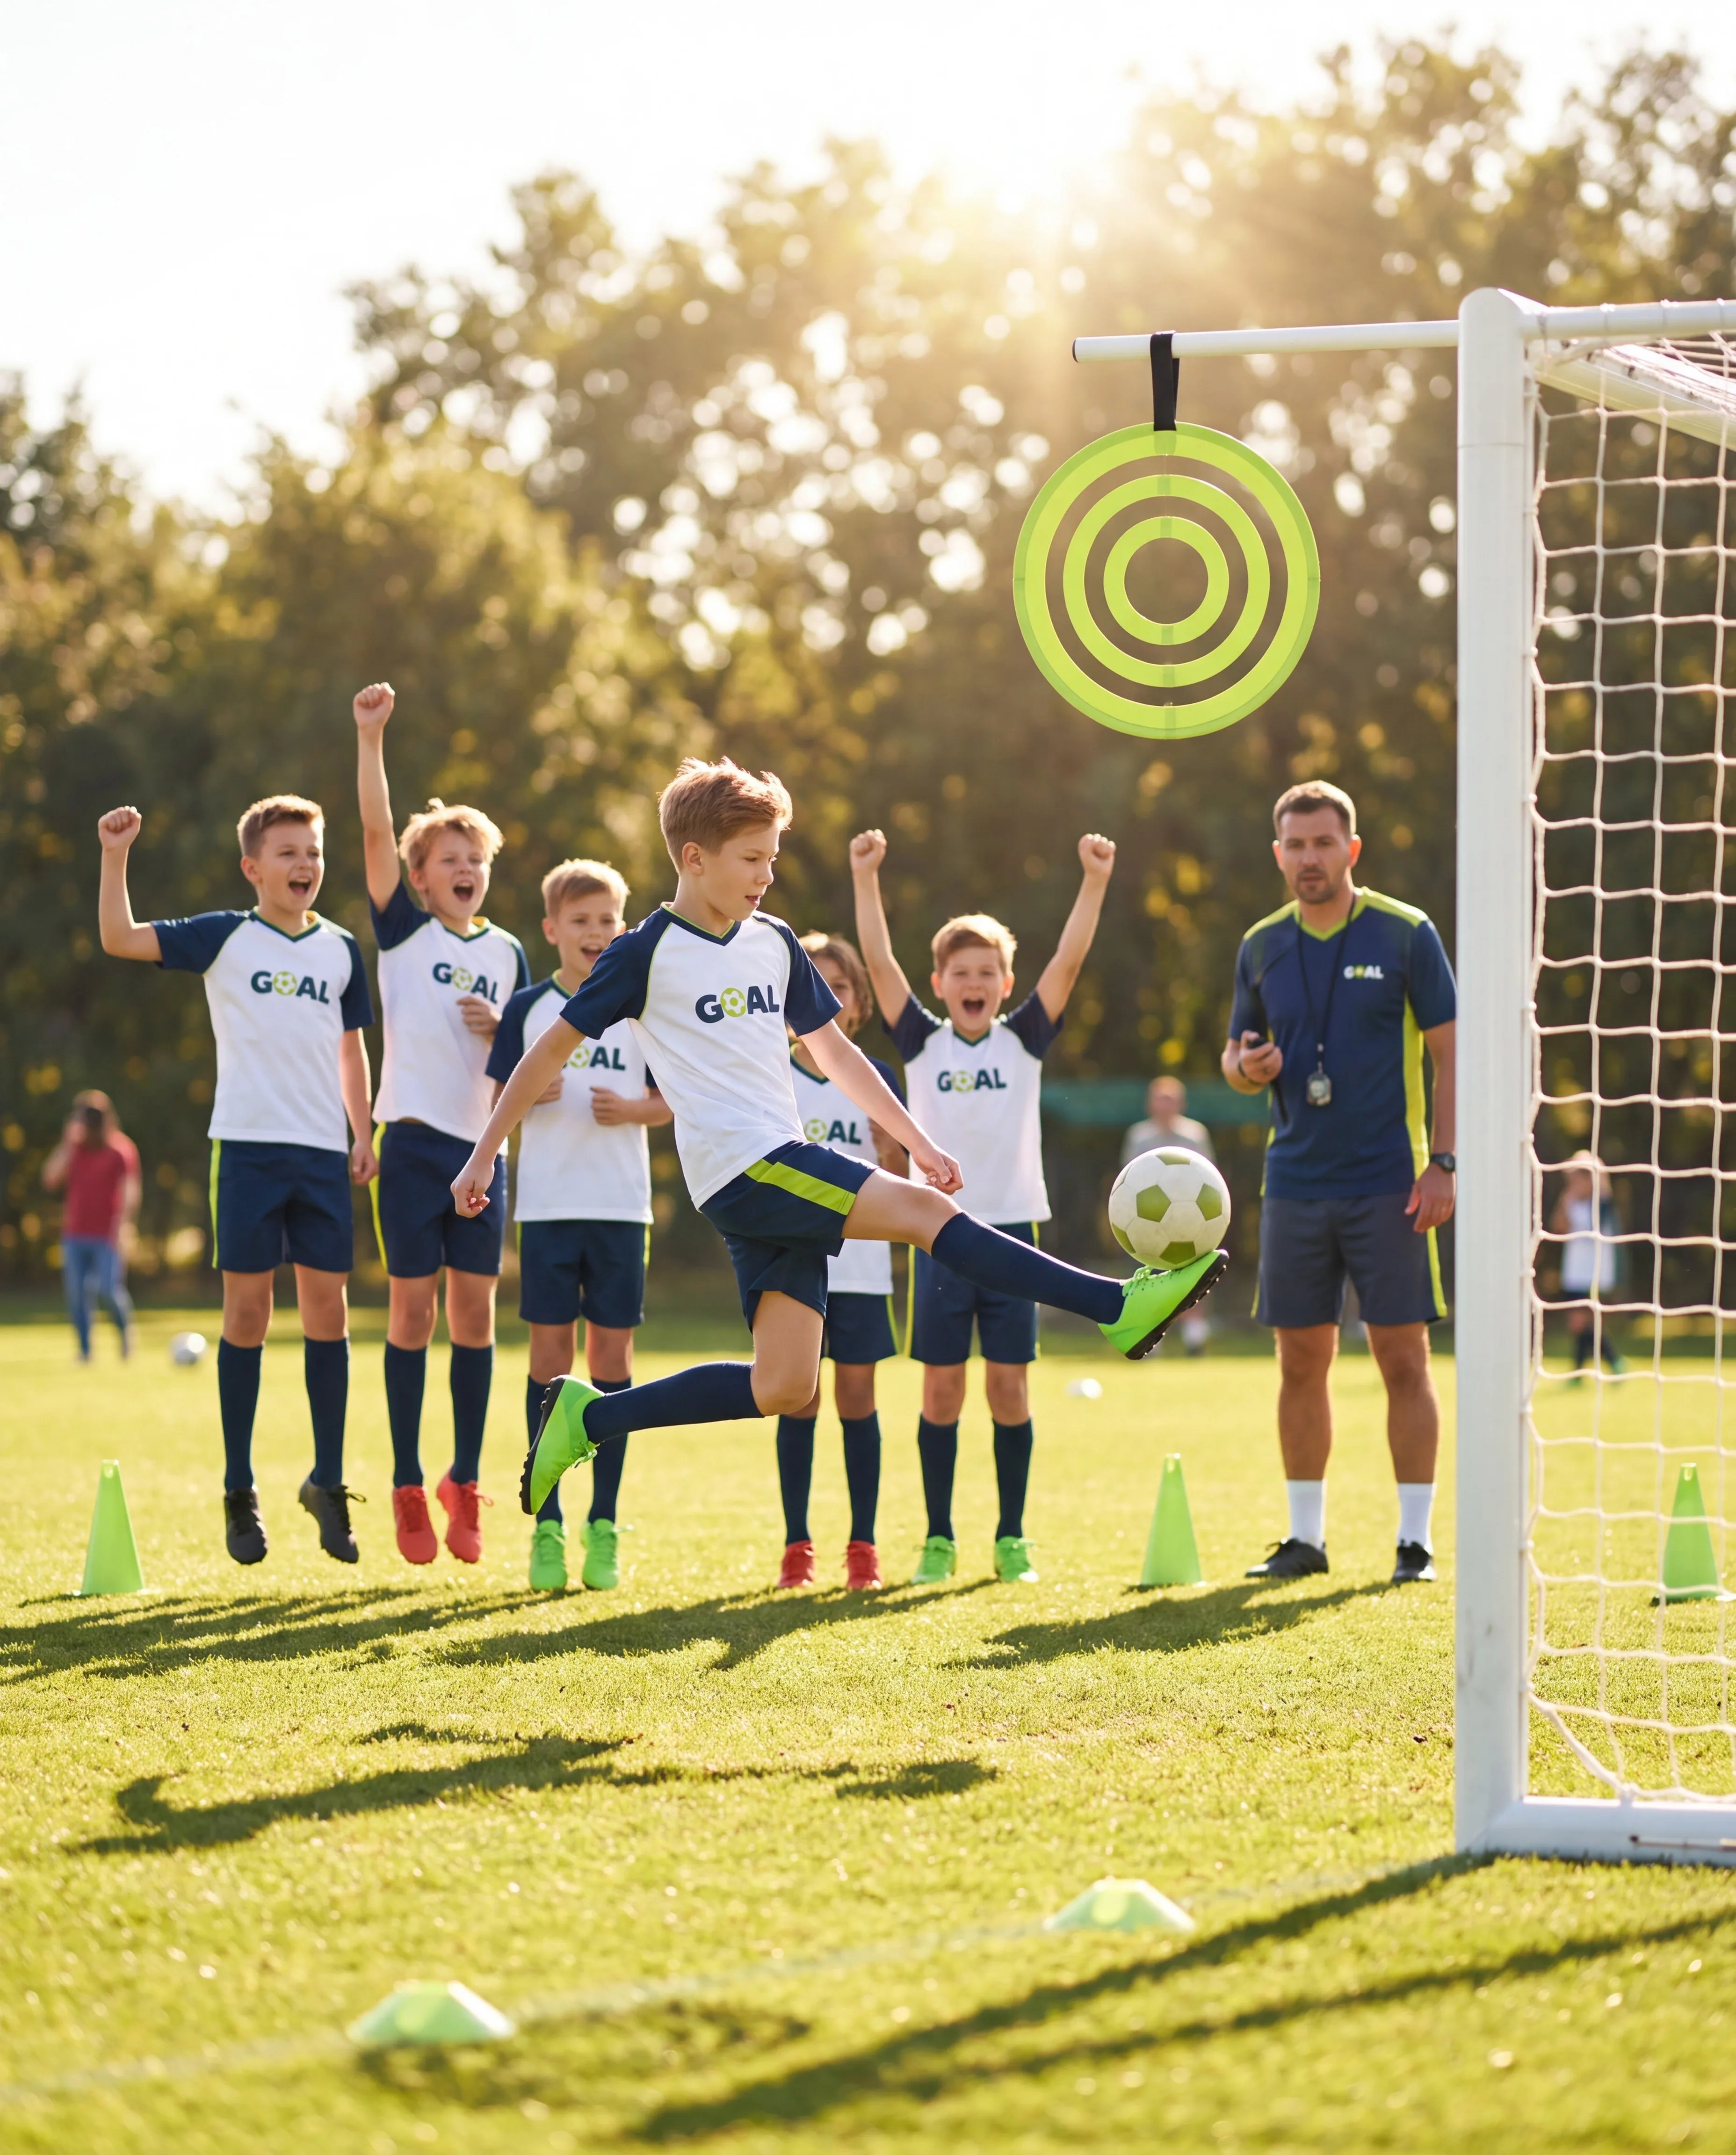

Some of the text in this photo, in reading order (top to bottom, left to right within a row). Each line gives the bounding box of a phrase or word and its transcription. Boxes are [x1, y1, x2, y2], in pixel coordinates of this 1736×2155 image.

[433, 962, 498, 1005] GOAL
[1343, 964, 1384, 980] GOAL
[251, 970, 330, 1005] GOAL
[695, 985, 779, 1023] GOAL
[562, 1044, 626, 1070] OAL
[937, 1068, 1007, 1093] GOAL
[804, 1118, 862, 1145] OAL
